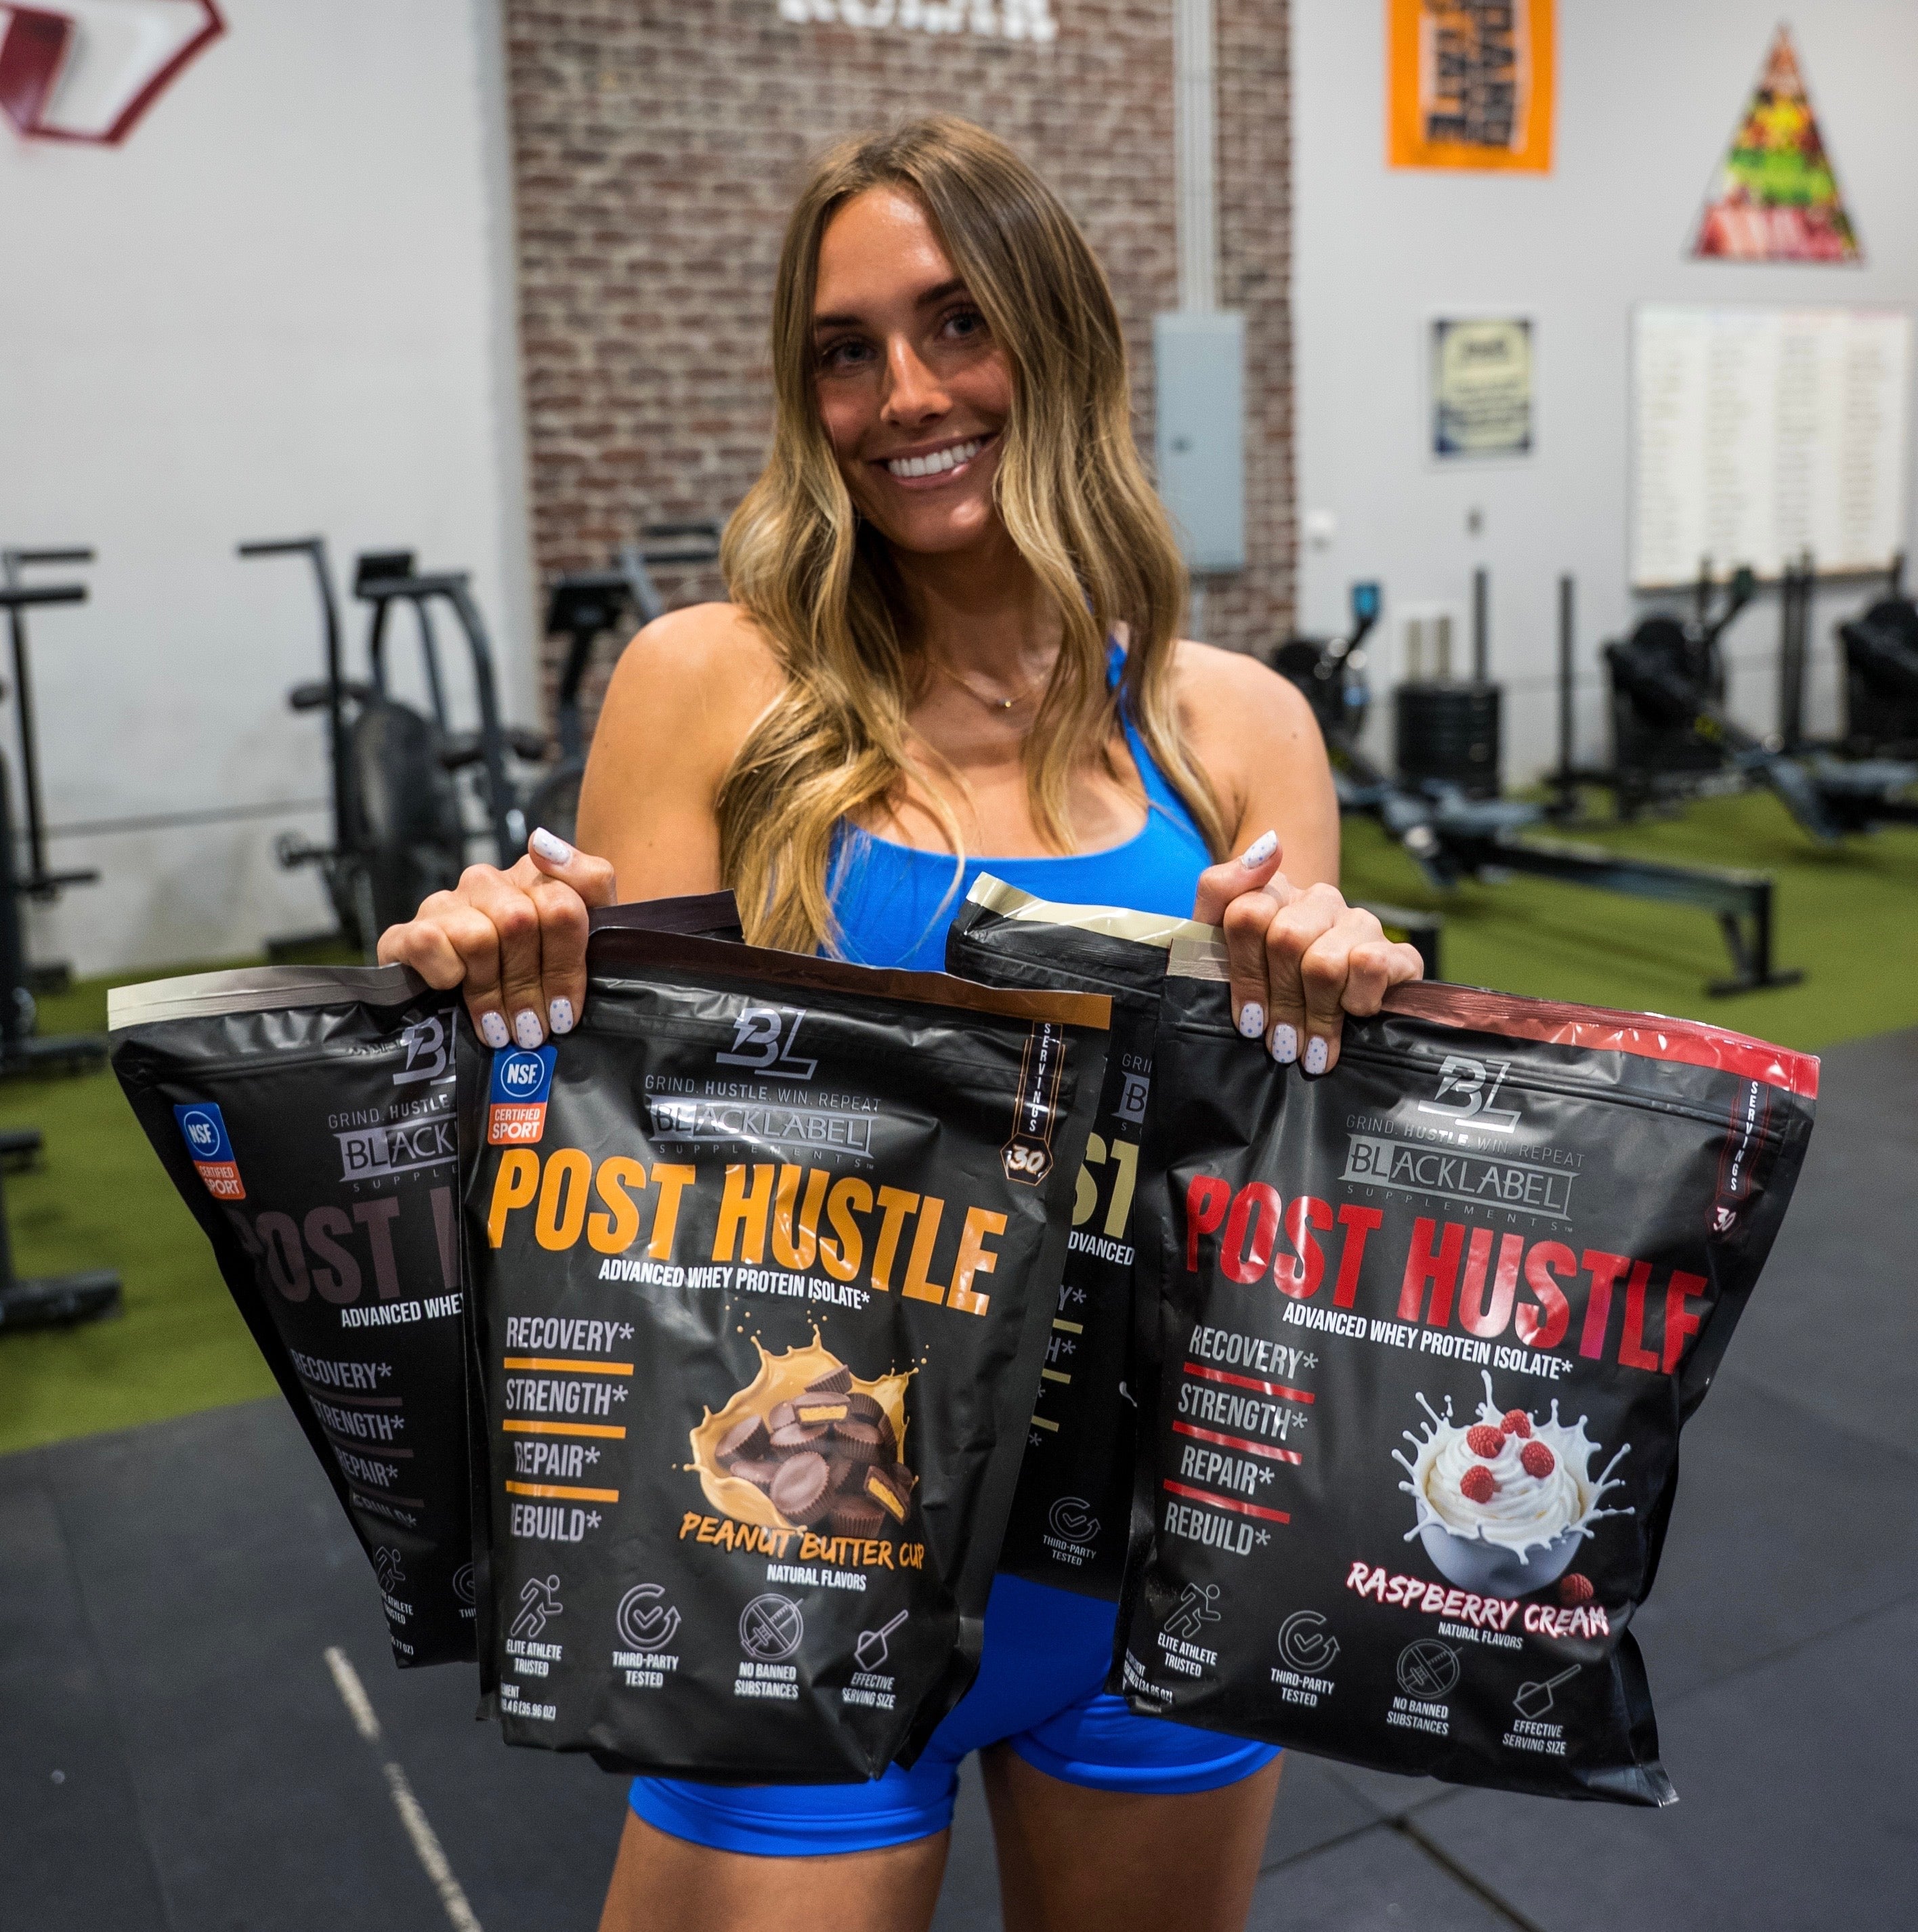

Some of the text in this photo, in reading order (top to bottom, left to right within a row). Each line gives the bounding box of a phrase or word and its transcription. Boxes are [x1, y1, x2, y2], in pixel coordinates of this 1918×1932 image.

[507, 1063, 538, 1085] NSF
[645, 1074, 881, 1112] GRIND. HUSTLE. WIN. REPEAT
[328, 1108, 385, 1129] GRIND.
[494, 1108, 540, 1121] CERTIFIED
[188, 1123, 212, 1143] NSF
[492, 1121, 540, 1139] SPORT
[1346, 1114, 1585, 1168] GRIND. HUSTLE. WIN. REPEAT
[345, 1120, 458, 1171] BLACK
[1008, 1143, 1046, 1175] 30
[199, 1165, 234, 1179] CERTIFIED
[353, 1164, 457, 1192] SUPPLE
[1350, 1143, 1561, 1209] BLACKLABEL
[205, 1178, 240, 1194] SPORT
[488, 1148, 696, 1261] POST
[711, 1163, 1008, 1316] HUSTLE
[1187, 1174, 1384, 1309] POST
[1068, 1230, 1135, 1265] DVANCED
[598, 1259, 685, 1287] ADVANCED
[687, 1265, 732, 1288] WHEY
[736, 1270, 806, 1298] PROTEIN
[341, 1302, 421, 1328] ADVANCED
[1282, 1301, 1367, 1339] ADVANCED
[1370, 1320, 1419, 1349] WHEY
[1420, 1330, 1491, 1362] PROTEIN
[511, 1503, 602, 1542] EBUILD
[679, 1511, 924, 1570] PEANUT BUTTER CUP
[1043, 1534, 1096, 1559] THIRD-PARTY
[1052, 1549, 1082, 1566] TESTED
[767, 1563, 867, 1592] NATURAL FLAVORS
[1346, 1561, 1610, 1639] RASPBERRY CREAM
[1438, 1621, 1523, 1650] NATURAL FLAVORS
[506, 1639, 562, 1660] ELITE ATHLETE
[612, 1651, 679, 1671] THIRD-PARTY
[1157, 1631, 1218, 1666] ELITE ATHLETE
[514, 1658, 549, 1677] TRUSTED
[739, 1662, 797, 1682] NO BANNED
[1165, 1652, 1201, 1678] TRUSTED
[625, 1670, 664, 1688] TESTED
[734, 1679, 799, 1700] SUBSTANCES
[850, 1672, 895, 1691] EFFECTIVE
[1271, 1667, 1334, 1694] THIRD-PARTY
[842, 1687, 895, 1710] SERVING SIZE
[1281, 1687, 1317, 1707] TESTED
[1392, 1696, 1448, 1719] NO BANNED
[1386, 1710, 1449, 1736] SUBSTANCES
[1513, 1719, 1563, 1738] EFFECTIVE
[1502, 1732, 1567, 1755] SERVING SIZE
